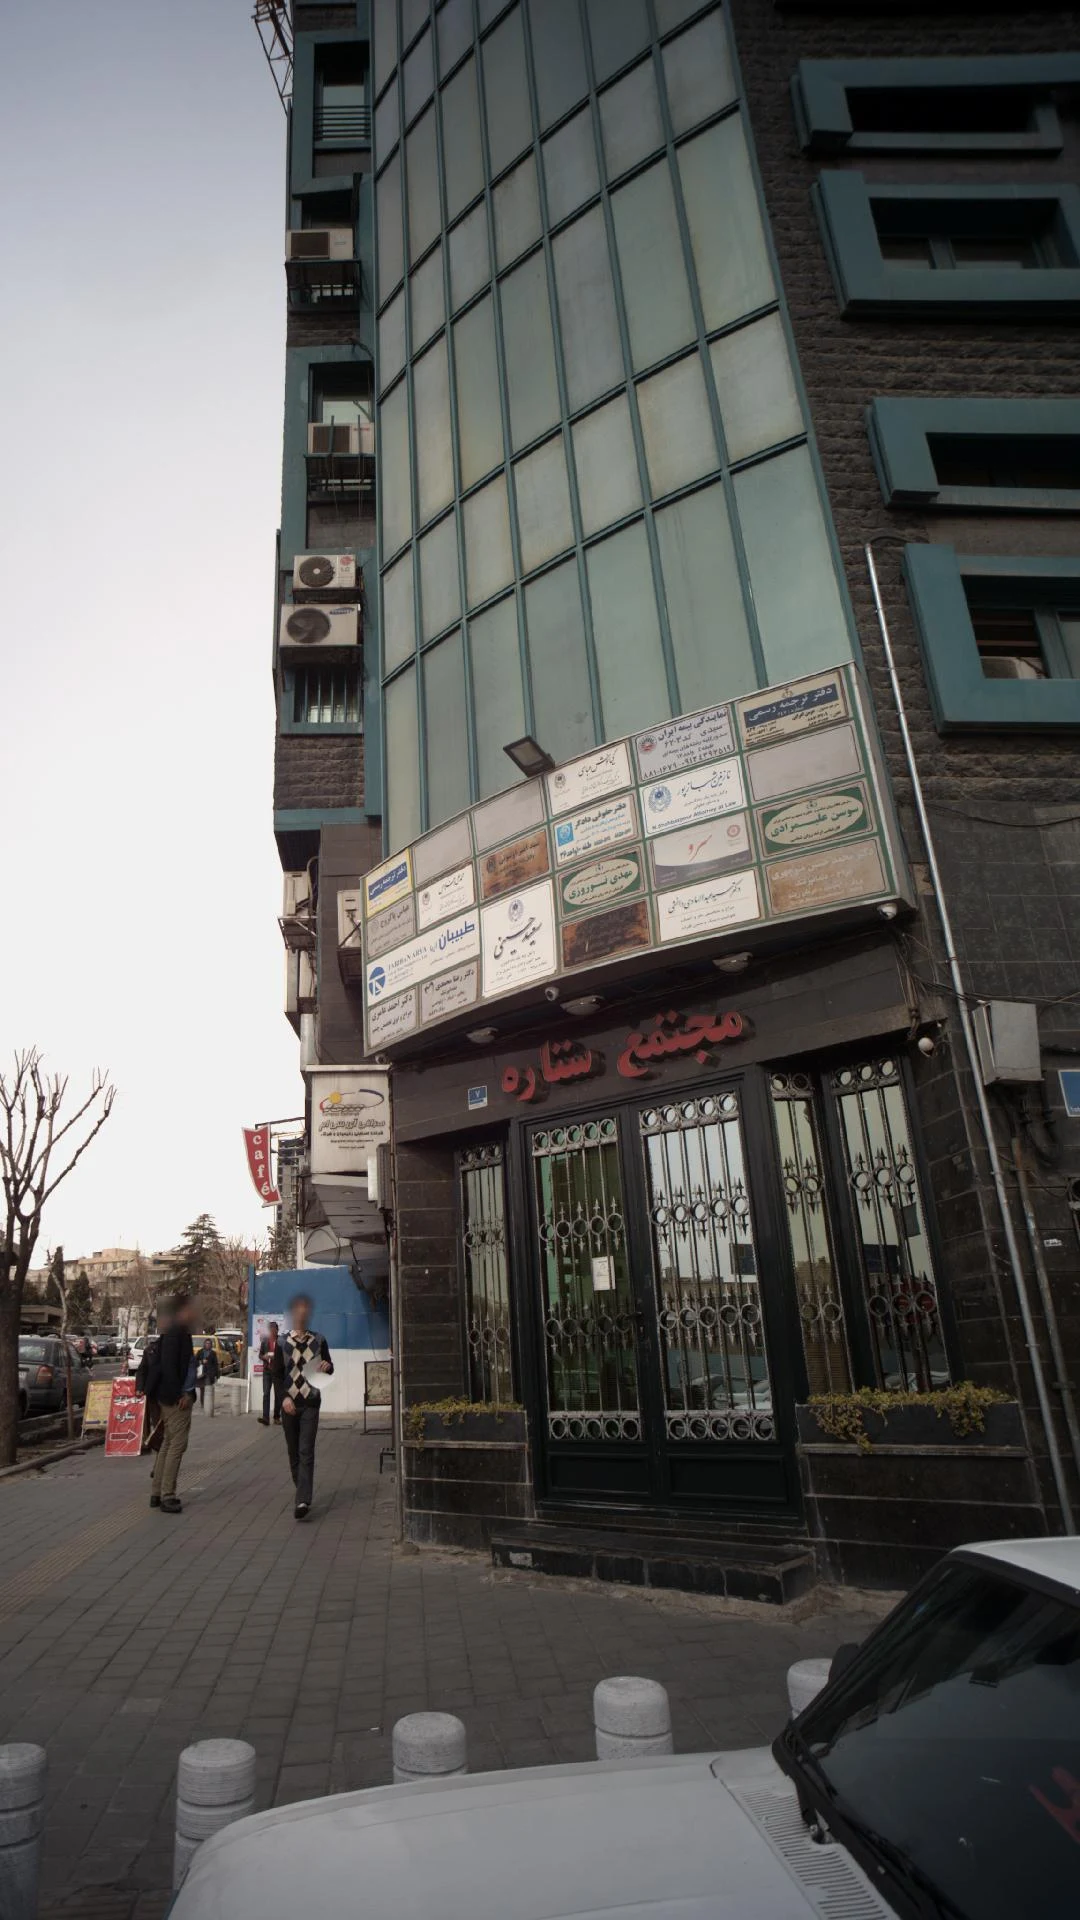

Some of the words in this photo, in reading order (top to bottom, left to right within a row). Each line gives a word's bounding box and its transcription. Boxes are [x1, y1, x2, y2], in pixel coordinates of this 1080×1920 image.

[779, 694, 808, 709] ترجمه
[812, 687, 833, 701] دفتر
[694, 710, 727, 729] نمایندگی
[749, 706, 777, 721] رسمی
[658, 726, 677, 741] ایران
[678, 723, 692, 732] بیمه
[832, 806, 859, 820] سوسن
[610, 870, 633, 884] مهدی
[569, 876, 608, 900] نوروزی
[439, 921, 475, 950] طبیبان
[493, 917, 536, 960] حسینی
[617, 1010, 743, 1078] مجتمع
[502, 1040, 592, 1101] ستاره
[253, 1135, 270, 1195] café
